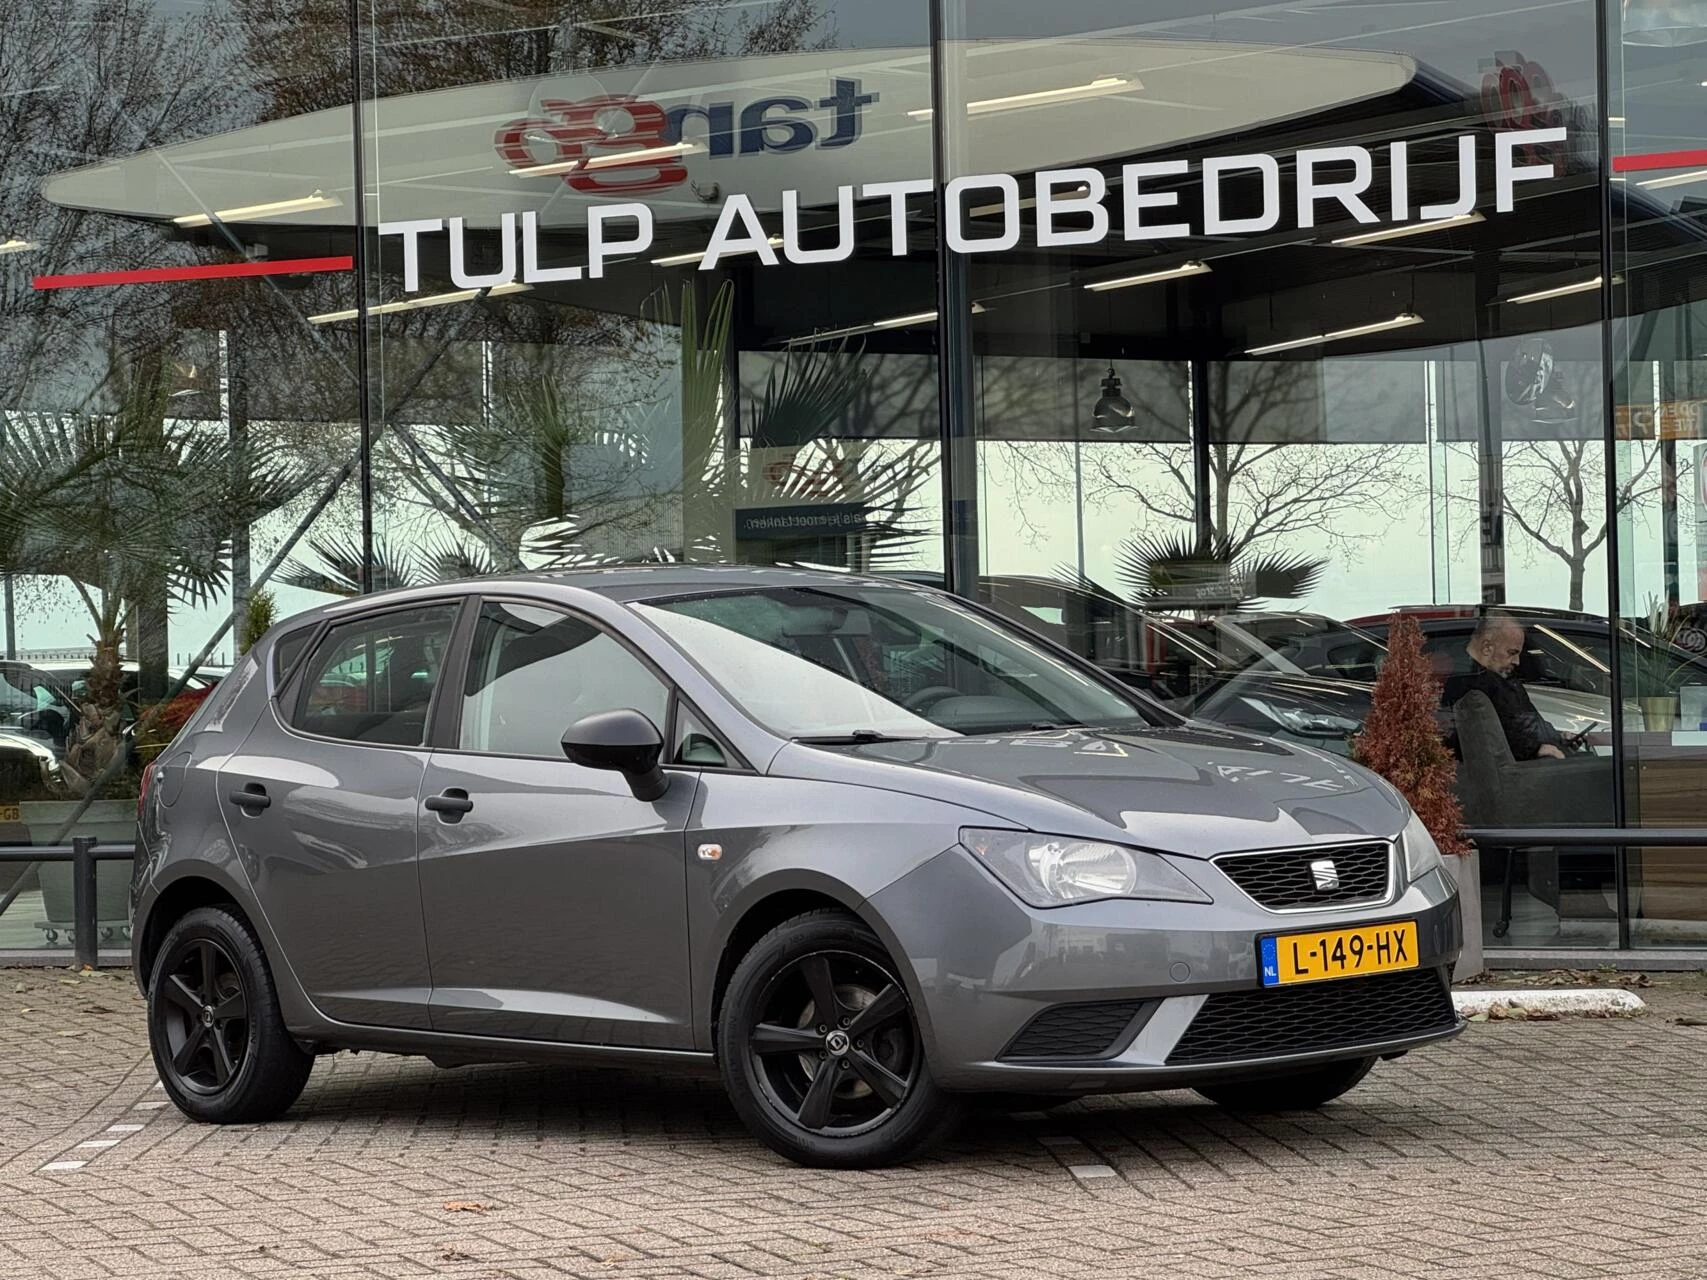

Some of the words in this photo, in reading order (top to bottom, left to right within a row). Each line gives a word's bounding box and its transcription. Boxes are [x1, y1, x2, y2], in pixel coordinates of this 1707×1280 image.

[378, 203, 653, 293] TULP
[698, 126, 1567, 271] AUTOBEDRIJF
[1264, 966, 1277, 977] NL
[1292, 928, 1408, 975] L-149-HX
